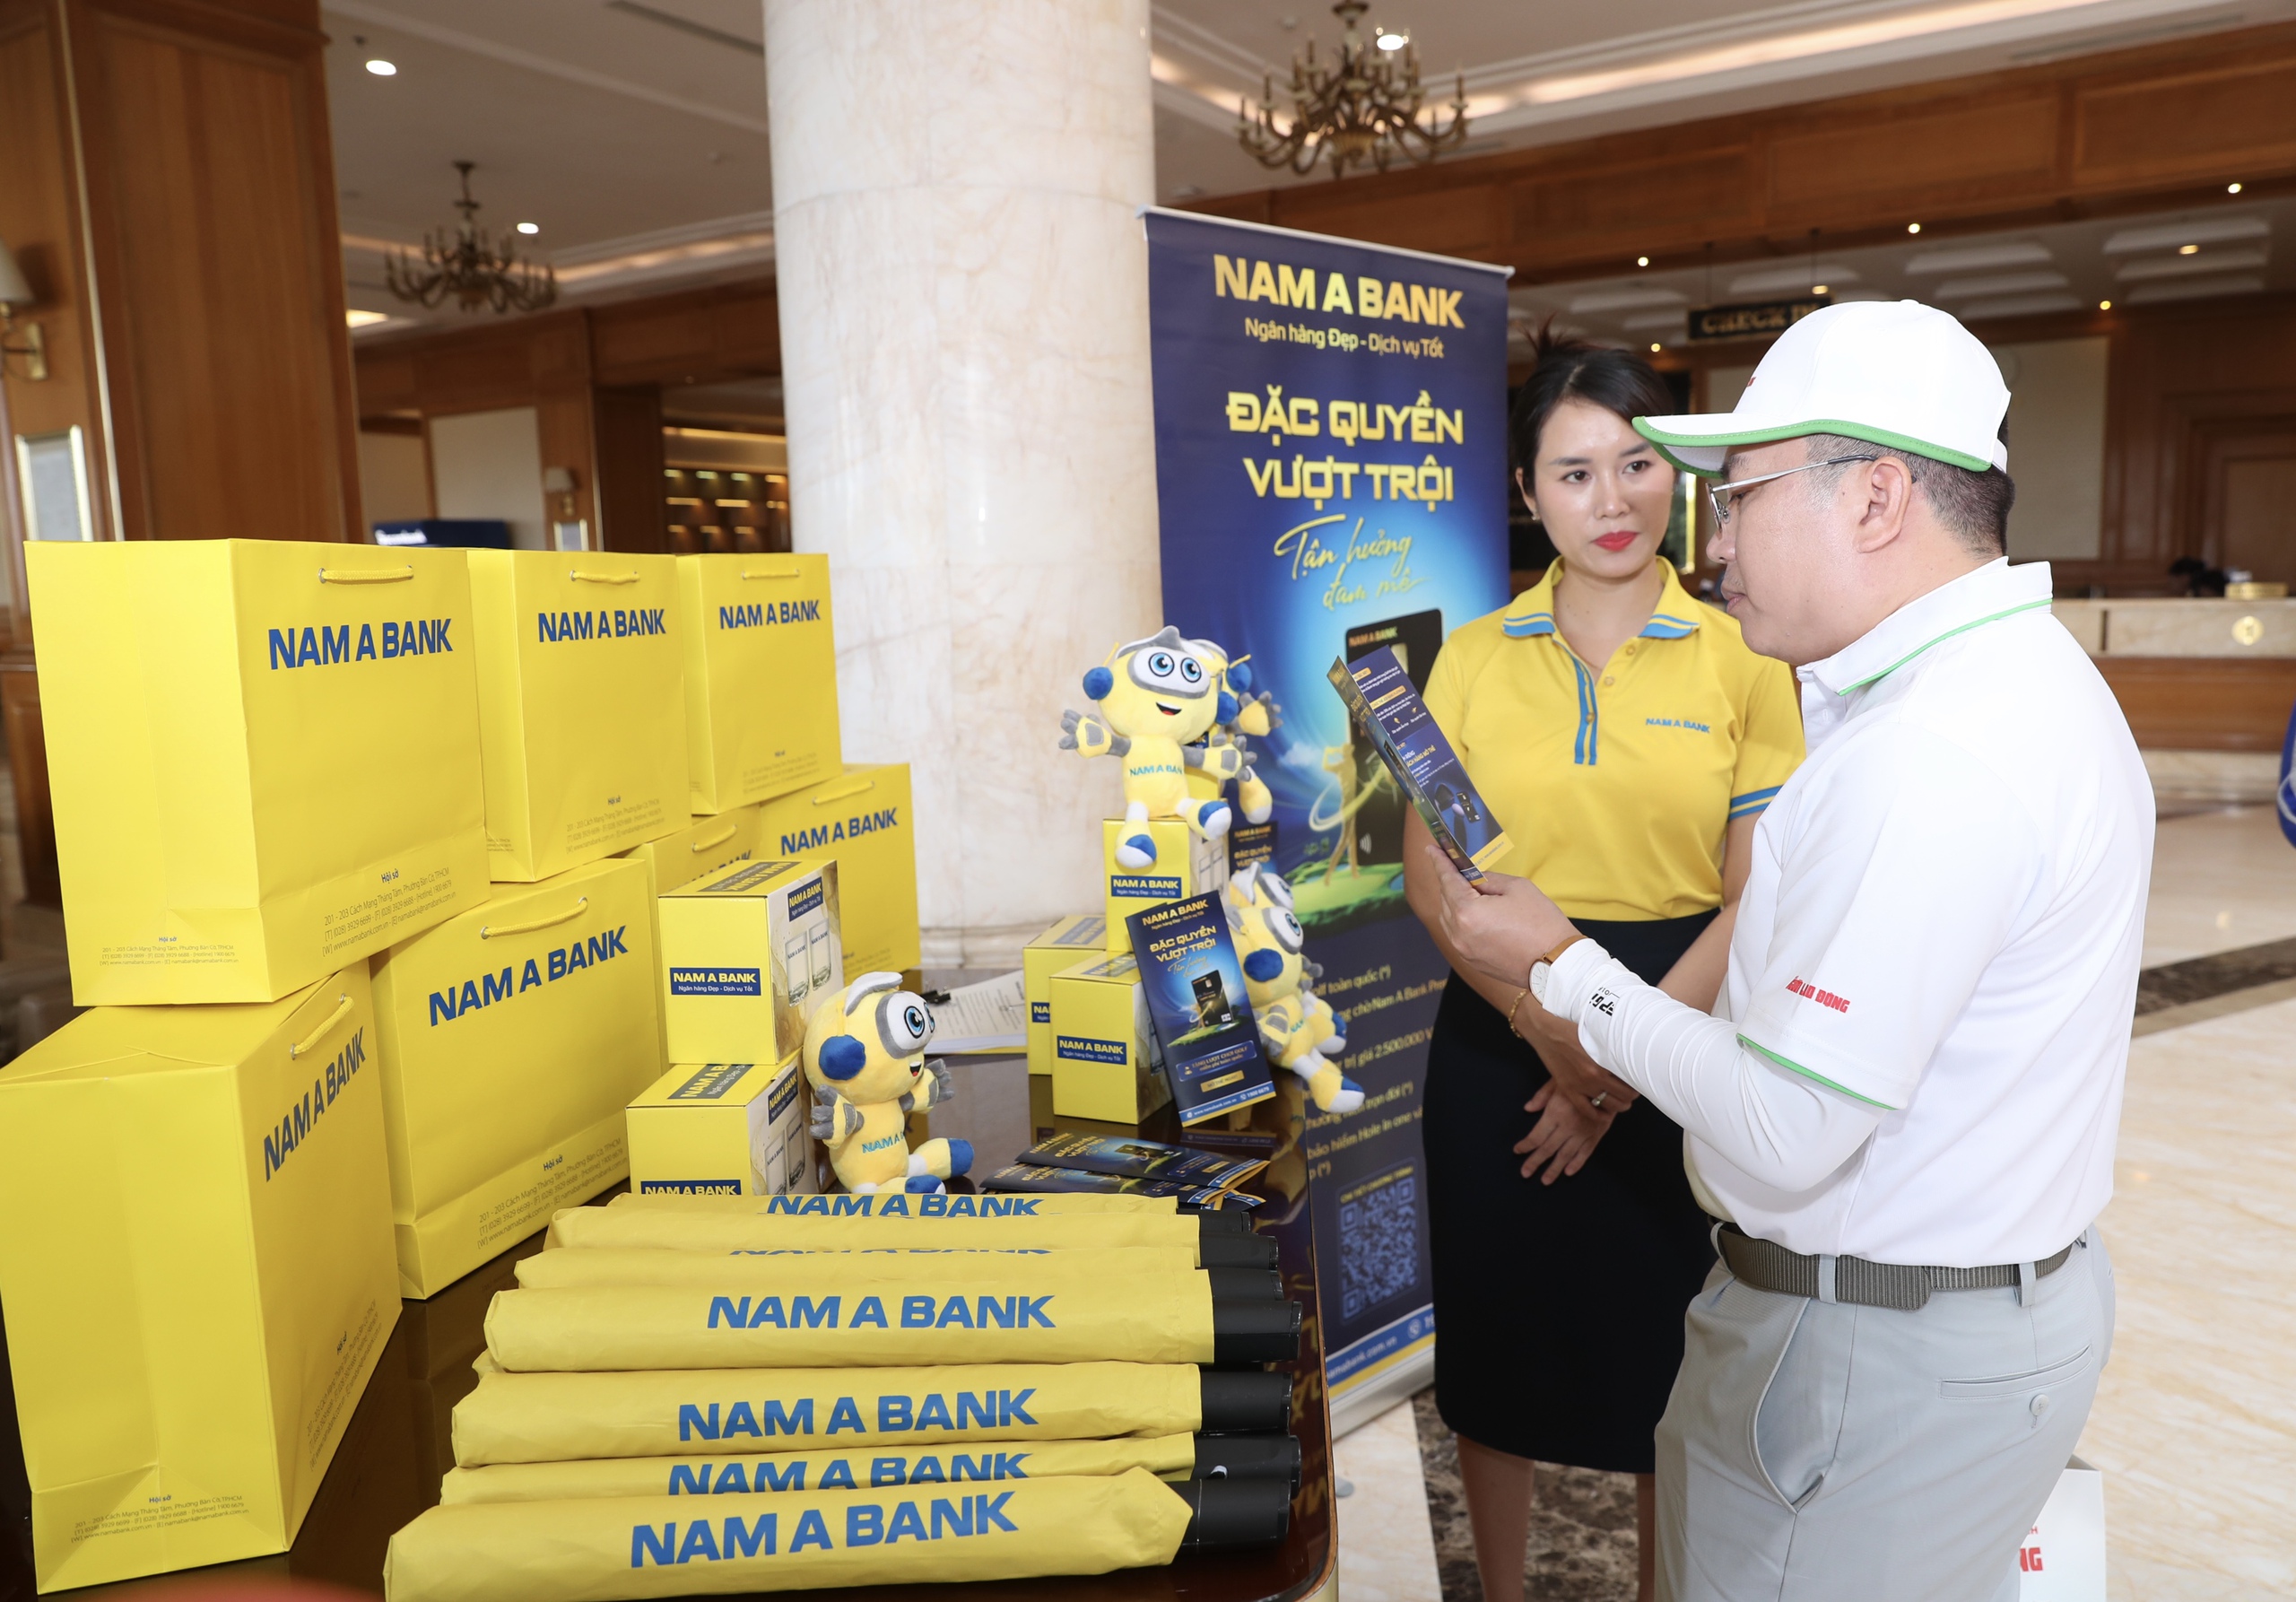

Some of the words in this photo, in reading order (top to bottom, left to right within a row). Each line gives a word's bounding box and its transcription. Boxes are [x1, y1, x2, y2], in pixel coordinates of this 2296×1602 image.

[1213, 254, 1316, 309] NAM
[1322, 273, 1353, 315] A
[1359, 276, 1465, 328] BANK
[1245, 318, 1286, 343] Ngân
[1289, 322, 1326, 349] hàng
[1327, 328, 1358, 352] Đẹp
[1369, 335, 1400, 355] Dịch
[1402, 341, 1420, 358] vụ
[1420, 336, 1445, 359] Tốt
[1226, 384, 1319, 447] ĐẶC
[1328, 390, 1464, 447] QUYỀN
[1242, 454, 1360, 511] VƯỢT
[1364, 454, 1454, 512] TRỘI
[1274, 514, 1345, 579] Tận
[1346, 518, 1412, 579] hưởng
[1323, 563, 1368, 610] đam
[1375, 569, 1431, 598] mê
[538, 611, 593, 643] NAM
[597, 611, 612, 639] A
[615, 608, 666, 638] BANK
[719, 603, 764, 630] NAM
[766, 603, 778, 626] A
[780, 599, 821, 624] BANK
[268, 624, 350, 670] NAM
[355, 623, 377, 662] A
[381, 618, 453, 658] BANK
[1646, 718, 1673, 727] NAM
[1674, 718, 1681, 727] A
[1683, 719, 1710, 734] BANK
[1129, 765, 1155, 776] NAM
[1156, 764, 1164, 772] A
[1166, 765, 1183, 775] BAN
[780, 825, 830, 856] NAM
[831, 823, 846, 841] A
[848, 807, 898, 839] BANK
[380, 872, 392, 884] Hội
[393, 867, 399, 879] sở
[1113, 879, 1137, 888] NAM
[1139, 879, 1148, 888] A
[1149, 879, 1178, 889] BANK
[789, 892, 802, 908] NAM
[807, 882, 822, 898] BANK
[324, 914, 335, 926] 201
[339, 909, 349, 920] 203
[349, 903, 363, 915] Cách
[363, 899, 378, 910] Mạng
[377, 892, 392, 904] Tháng
[1142, 912, 1169, 926] NAM
[1170, 910, 1177, 919] A
[1178, 900, 1208, 915] BANK
[347, 920, 359, 932] 3929
[359, 914, 371, 927] 6699
[1149, 938, 1176, 953] ĐẶC
[1176, 926, 1217, 945] QUYỀN
[1156, 946, 1188, 962] VƯỢT
[1188, 937, 1216, 953] TRỘI
[428, 965, 514, 1026] NAM
[518, 959, 543, 992] A
[546, 925, 628, 981] BANK
[674, 972, 706, 983] NAM
[707, 972, 717, 983] A
[718, 972, 757, 983] BANK
[708, 985, 718, 993] Đẹp
[744, 984, 752, 992] Tốt
[1328, 977, 1352, 994] toàn
[1353, 968, 1378, 988] quốc
[1372, 996, 1395, 1010] Nam
[1396, 989, 1404, 1003] A
[1404, 984, 1427, 1000] Bank
[1814, 989, 1851, 1014] ĐỘNG
[1059, 1040, 1084, 1050] NAM
[1085, 1043, 1092, 1051] A
[1094, 1043, 1124, 1054] BANK
[1358, 1047, 1374, 1067] giá
[1375, 1030, 1425, 1059] 2.500.000
[681, 1078, 715, 1097] NAM
[706, 1070, 720, 1078] A
[769, 1093, 780, 1110] NAM
[785, 1073, 797, 1093] BANK
[1386, 1085, 1401, 1102] đời
[263, 1091, 310, 1182] NAM
[313, 1078, 326, 1125] A
[326, 1025, 367, 1106] BANK
[862, 1136, 893, 1154] NAM
[894, 1133, 900, 1145] A
[1330, 1133, 1357, 1152] hiểm
[1358, 1123, 1381, 1141] Hole
[1382, 1119, 1392, 1131] in
[1393, 1111, 1413, 1127] one
[544, 1161, 554, 1171] Hội
[555, 1154, 563, 1163] sở
[645, 1186, 680, 1195] NAM
[681, 1186, 692, 1195] A
[694, 1185, 736, 1195] BANK
[767, 1196, 874, 1217] NAM
[878, 1195, 909, 1217] A
[919, 1194, 1045, 1217] BANK
[707, 1296, 841, 1328] NAM
[848, 1296, 890, 1328] A
[900, 1295, 1056, 1328] BANK
[679, 1397, 814, 1441] NAM
[825, 1397, 866, 1435] A
[878, 1388, 1039, 1432] BANK
[668, 1461, 807, 1495] NAM
[817, 1458, 859, 1490] A
[870, 1452, 1033, 1488] BANK
[149, 1495, 161, 1503] Hội
[631, 1512, 778, 1568] NAM
[788, 1509, 833, 1554] A
[846, 1491, 1019, 1547] BANK
